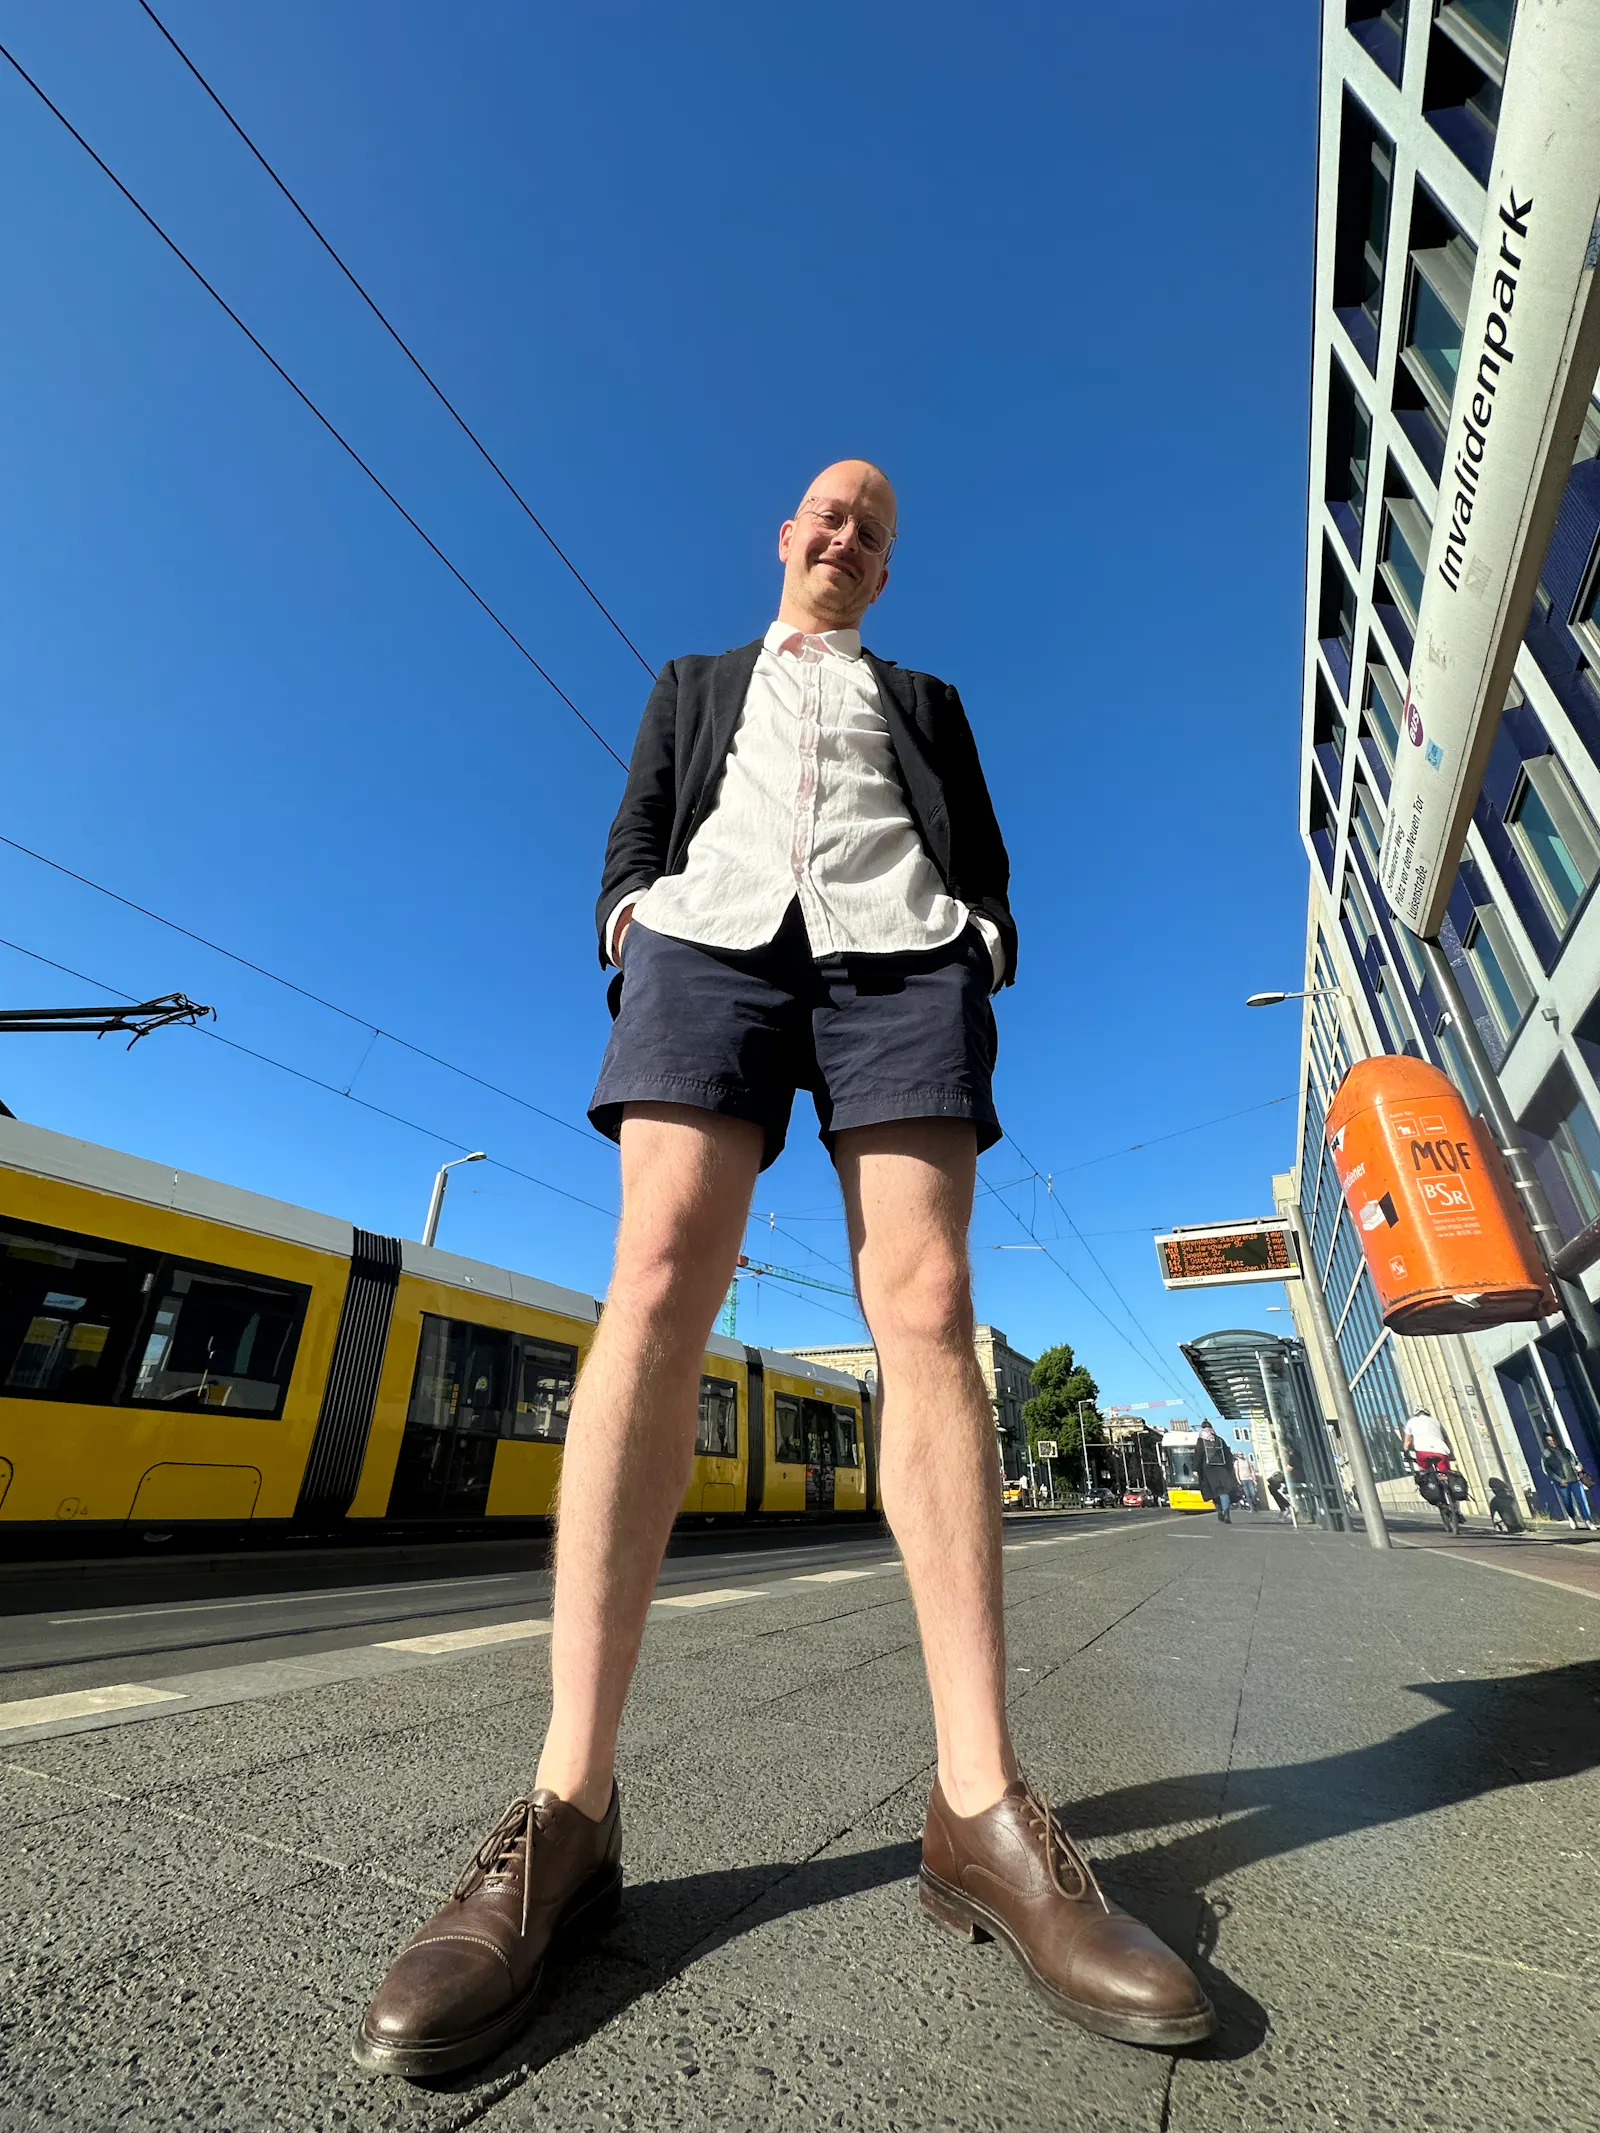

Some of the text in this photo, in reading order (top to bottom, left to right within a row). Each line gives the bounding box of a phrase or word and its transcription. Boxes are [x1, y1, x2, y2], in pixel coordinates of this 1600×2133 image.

[1438, 185, 1534, 593] Invalidenpark
[1409, 708, 1420, 743] BUS
[1387, 846, 1399, 893] Schwarzer
[1394, 825, 1405, 848] Weg
[1395, 794, 1424, 907] Platz vor dem Neuen Tor
[1407, 865, 1428, 920] Luisenstraße
[1410, 1139, 1472, 1172] MOF
[1424, 1182, 1467, 1206] BSR
